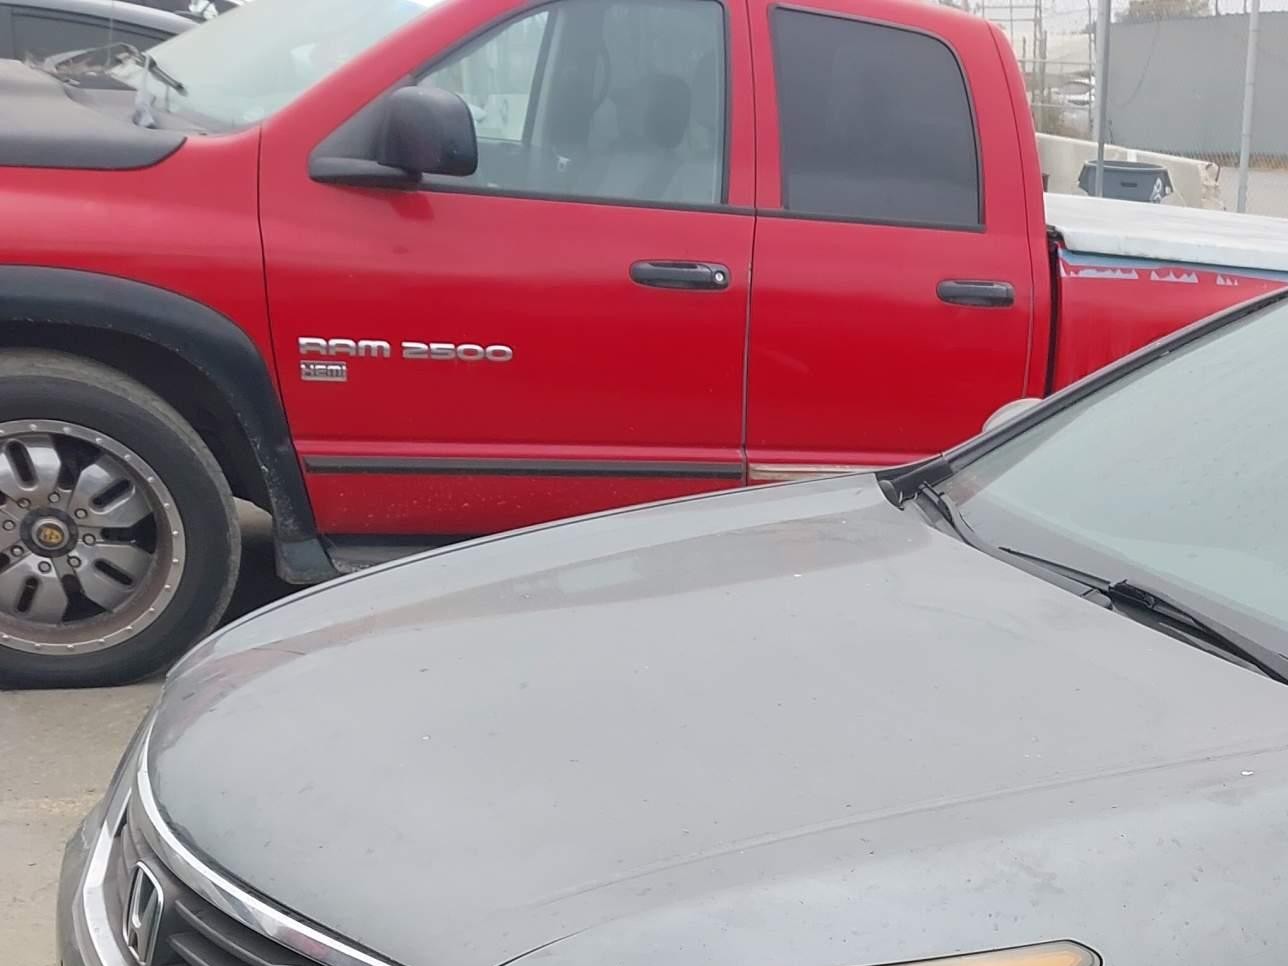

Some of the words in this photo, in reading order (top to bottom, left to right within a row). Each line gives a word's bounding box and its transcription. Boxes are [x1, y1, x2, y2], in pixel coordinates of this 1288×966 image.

[298, 336, 391, 358] RAM
[401, 341, 513, 362] 2500
[300, 361, 347, 380] HEMI
